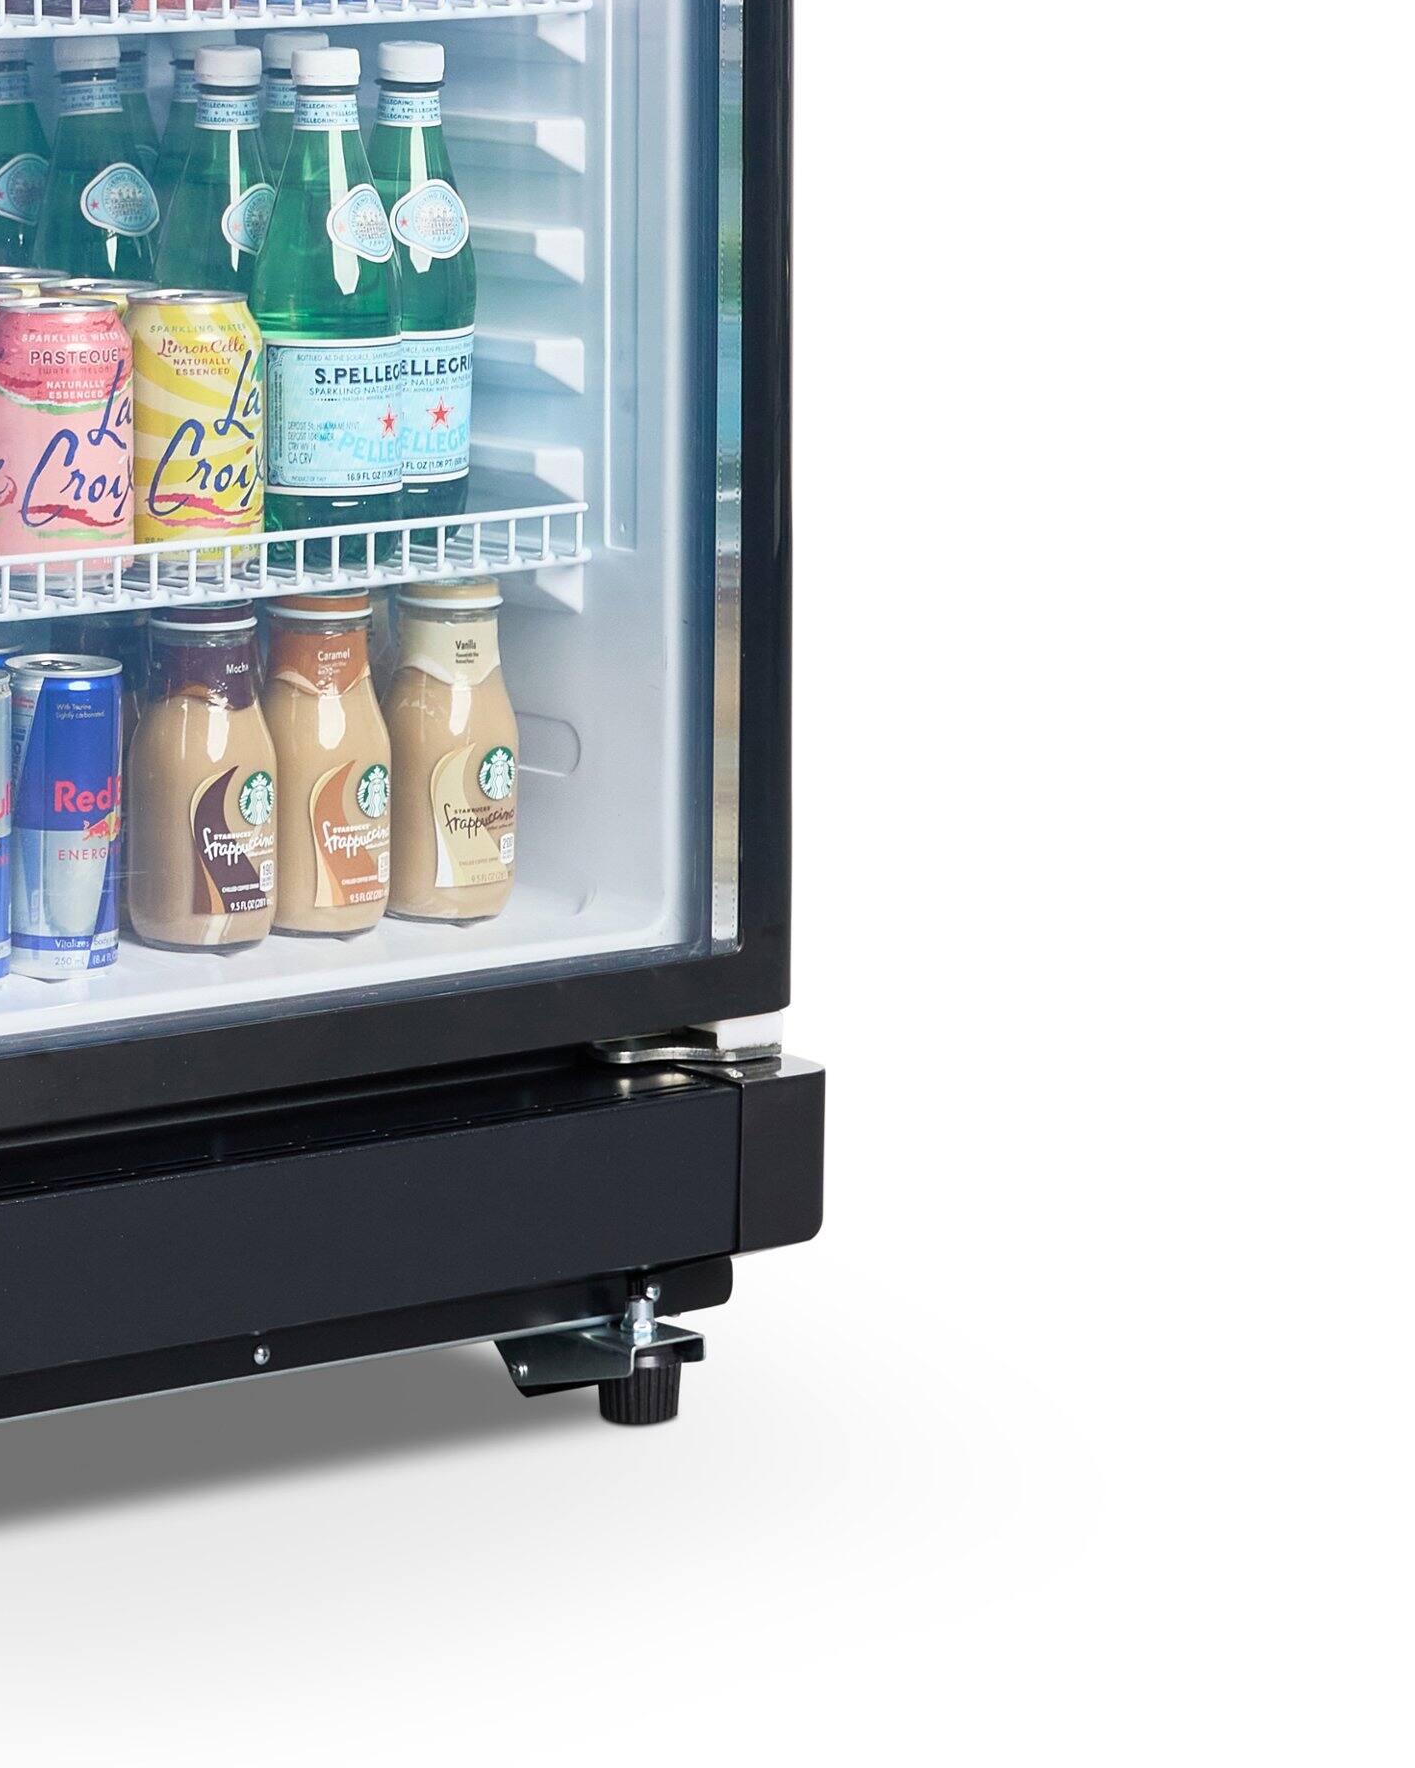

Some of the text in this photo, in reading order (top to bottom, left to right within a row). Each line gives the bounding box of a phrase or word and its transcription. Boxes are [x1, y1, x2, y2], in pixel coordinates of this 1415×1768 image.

[150, 325, 214, 333] SPARKLING
[21, 334, 86, 342] SPARKLING
[158, 336, 244, 357] LimonCello
[30, 349, 117, 364] PASTEQUE
[47, 381, 105, 389] NATURALLY
[310, 387, 361, 395] SPARKLING
[49, 391, 103, 399] ESSENCED
[214, 350, 260, 439] La
[88, 359, 132, 449] La
[149, 419, 265, 516] Croix
[417, 461, 427, 469] OZ
[22, 429, 134, 528] Croix
[363, 472, 370, 480] FL
[455, 640, 476, 650] Vanilla
[318, 649, 350, 663] Caramel
[226, 663, 249, 675] Mocha
[55, 776, 112, 812] Red
[444, 803, 514, 839] frappuccino
[203, 828, 274, 866] frappuccino
[58, 848, 106, 860] ENERG
[56, 940, 89, 948] Vitalizes
[93, 955, 106, 964] (8.4
